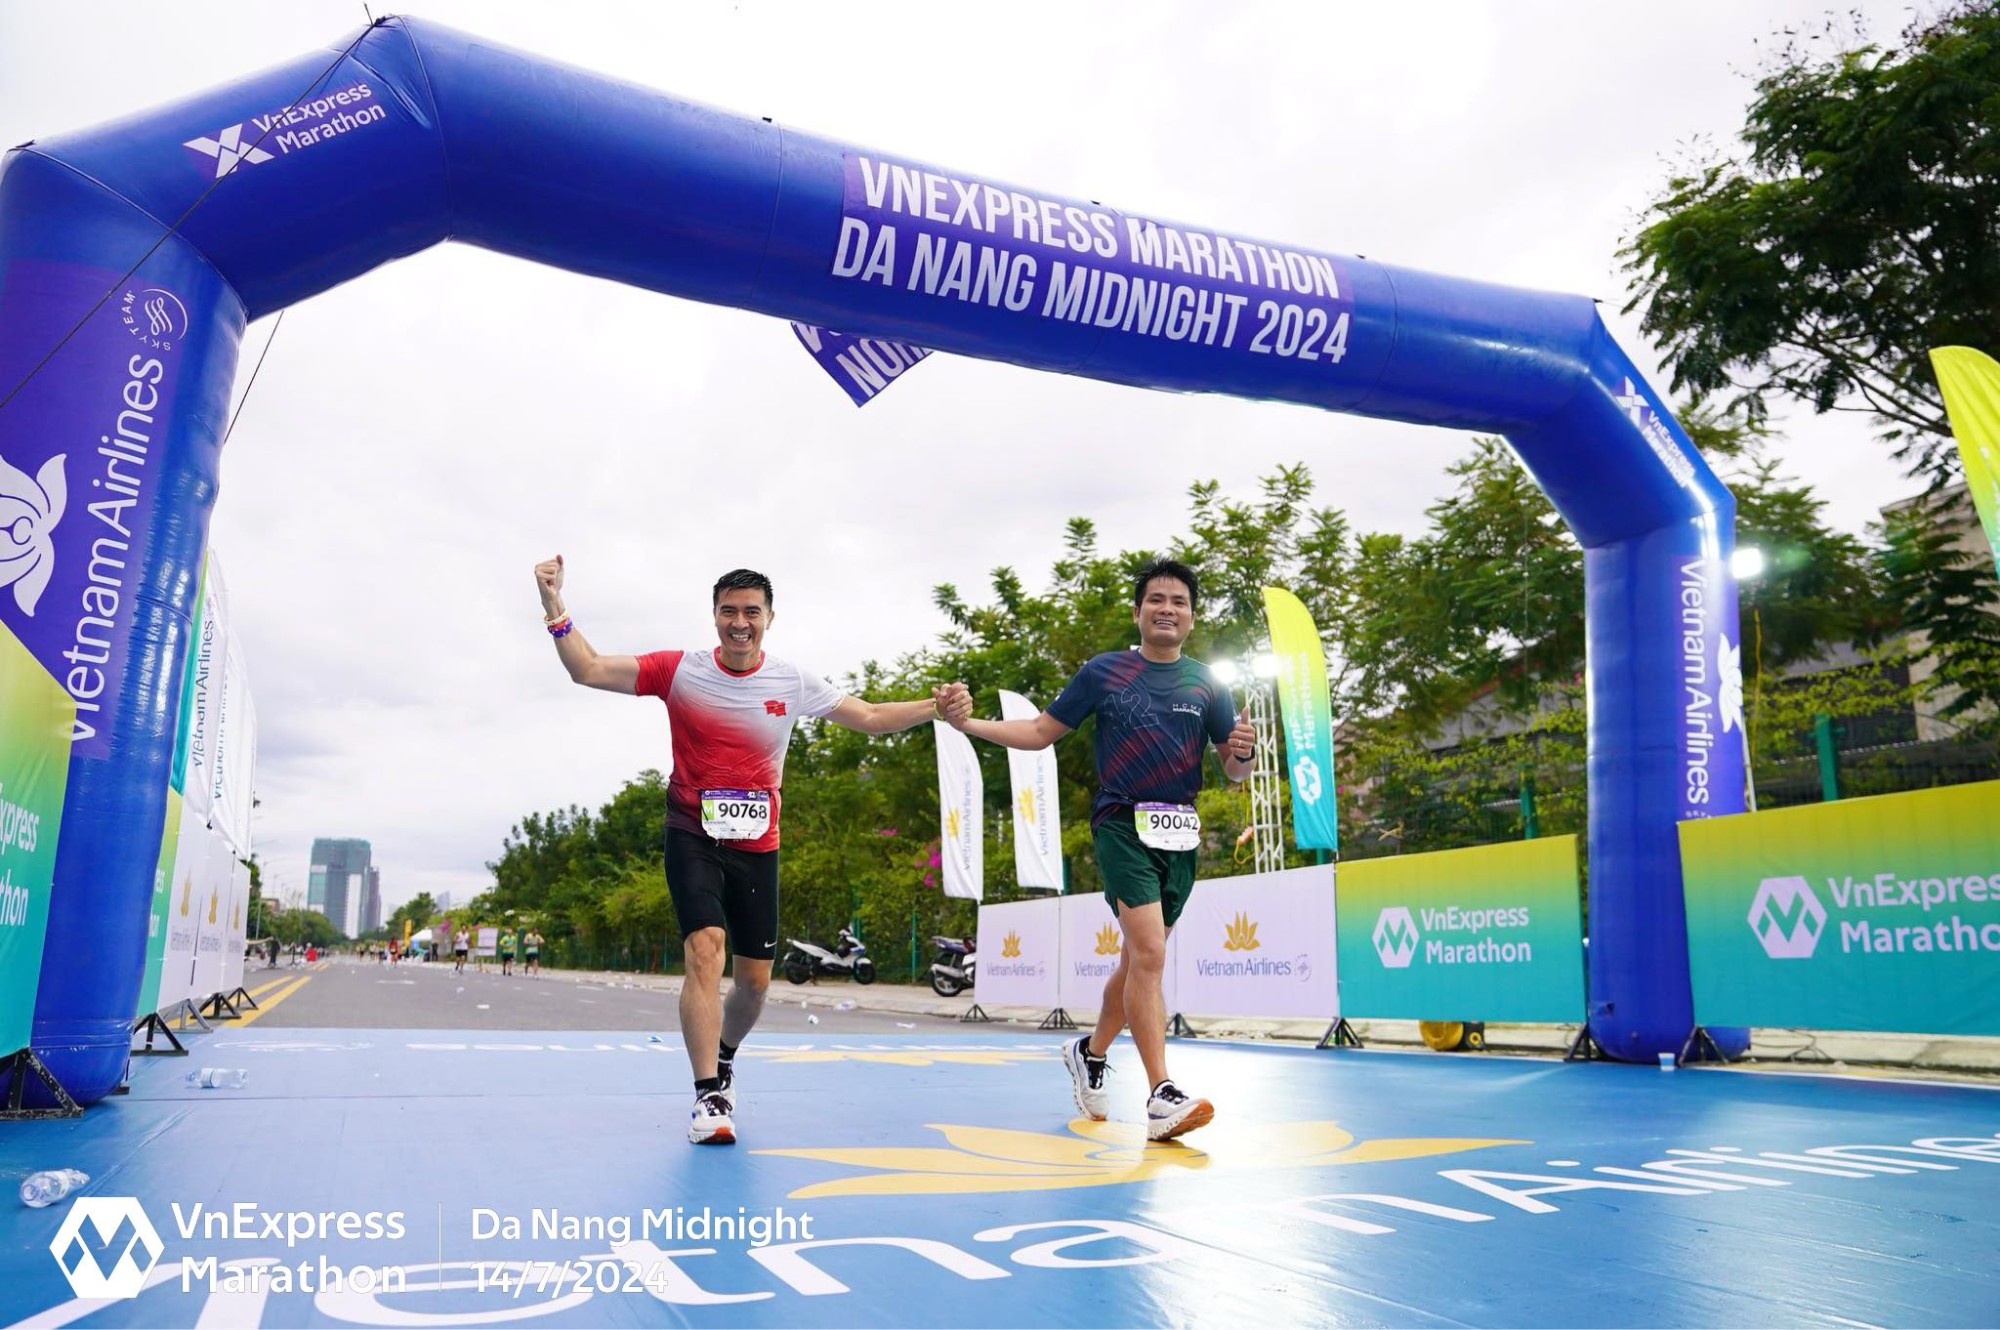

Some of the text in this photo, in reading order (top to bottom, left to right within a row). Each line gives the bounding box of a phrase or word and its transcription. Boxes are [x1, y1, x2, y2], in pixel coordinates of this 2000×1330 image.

[251, 83, 372, 133] VnExpress
[275, 104, 386, 154] Marathon
[858, 157, 1340, 300] VNEXPRESS MARATHON
[832, 216, 1350, 364] DA NANG MIDNIGHT 2024
[718, 802, 768, 819] 90768
[1150, 814, 1198, 830] 90042
[1420, 905, 1529, 934] VnExpress
[1425, 937, 1532, 963] Marathon
